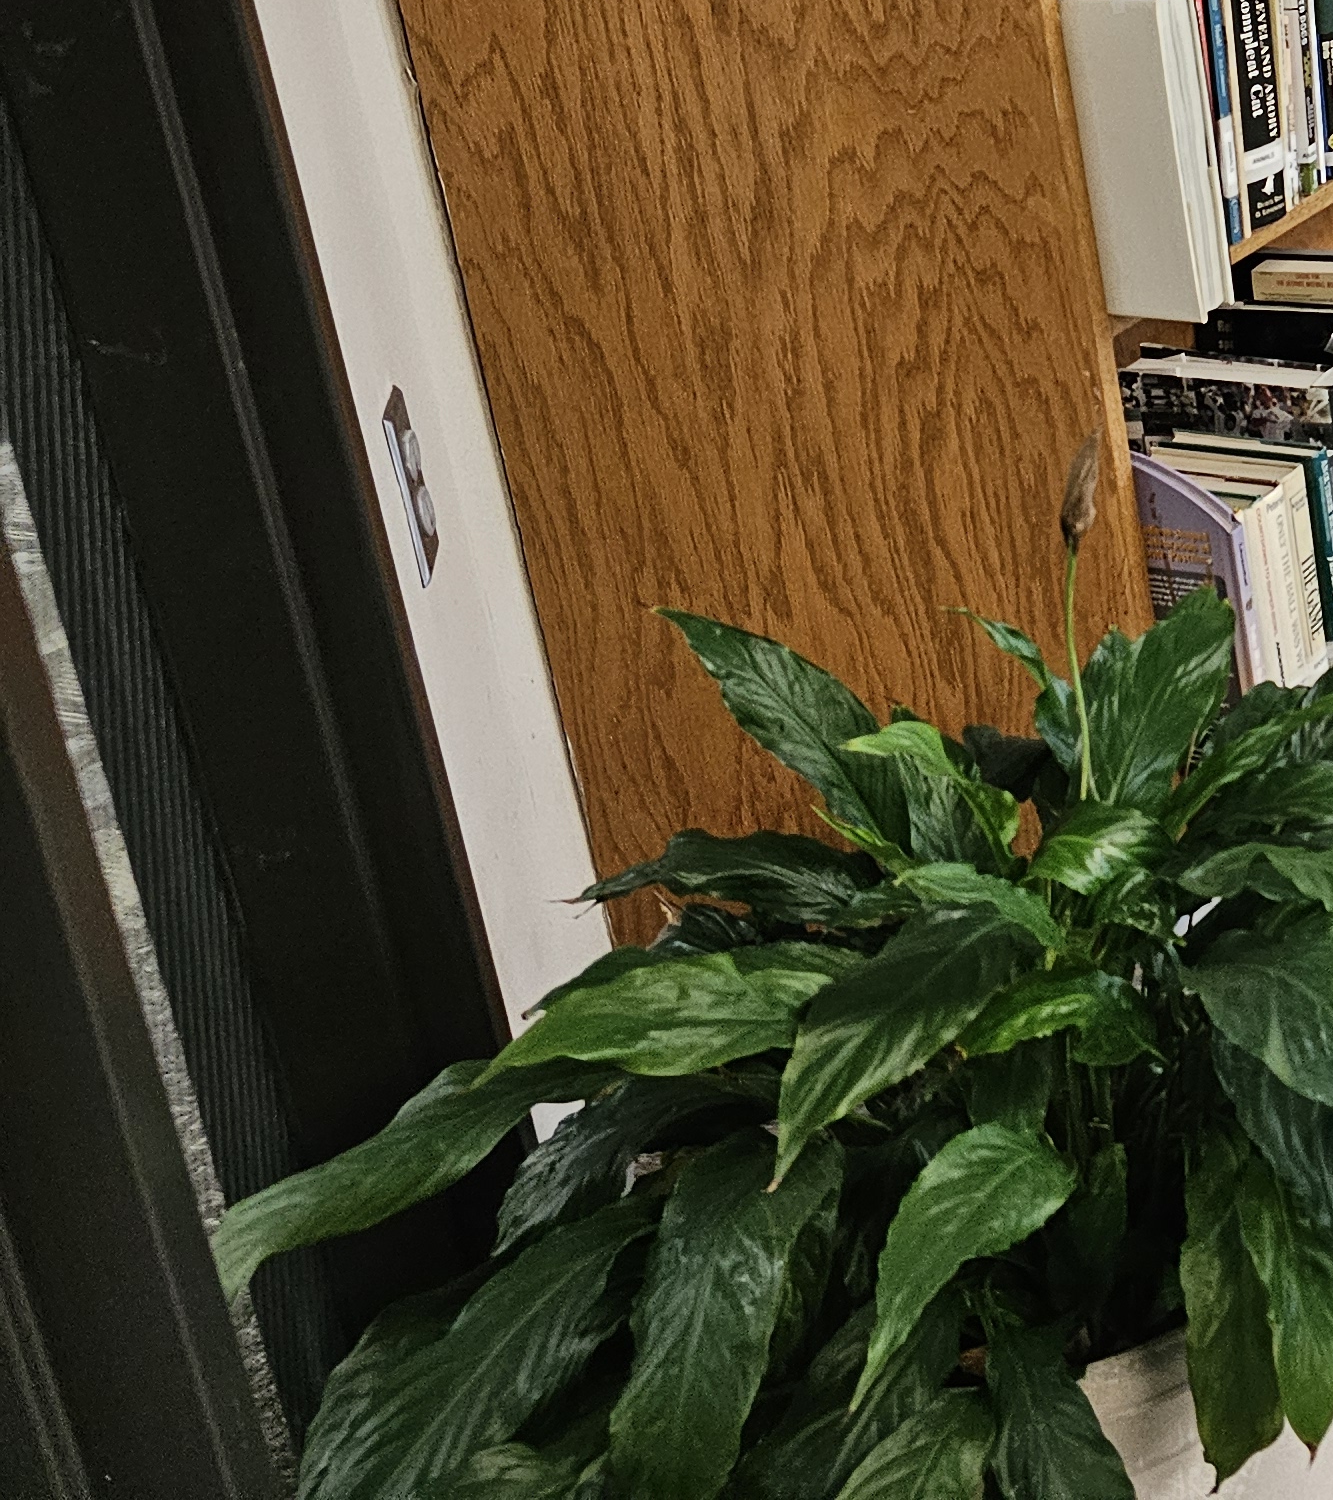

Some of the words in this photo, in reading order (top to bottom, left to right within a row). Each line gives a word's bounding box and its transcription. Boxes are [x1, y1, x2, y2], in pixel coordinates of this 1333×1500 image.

[1298, 15, 1308, 46] DOGS
[1249, 84, 1265, 118] Cat
[1264, 83, 1280, 137] AMORY
[1279, 551, 1293, 582] THE
[1301, 553, 1316, 591] THE
[1284, 585, 1298, 615] BALL
[1304, 589, 1325, 641] GAME
